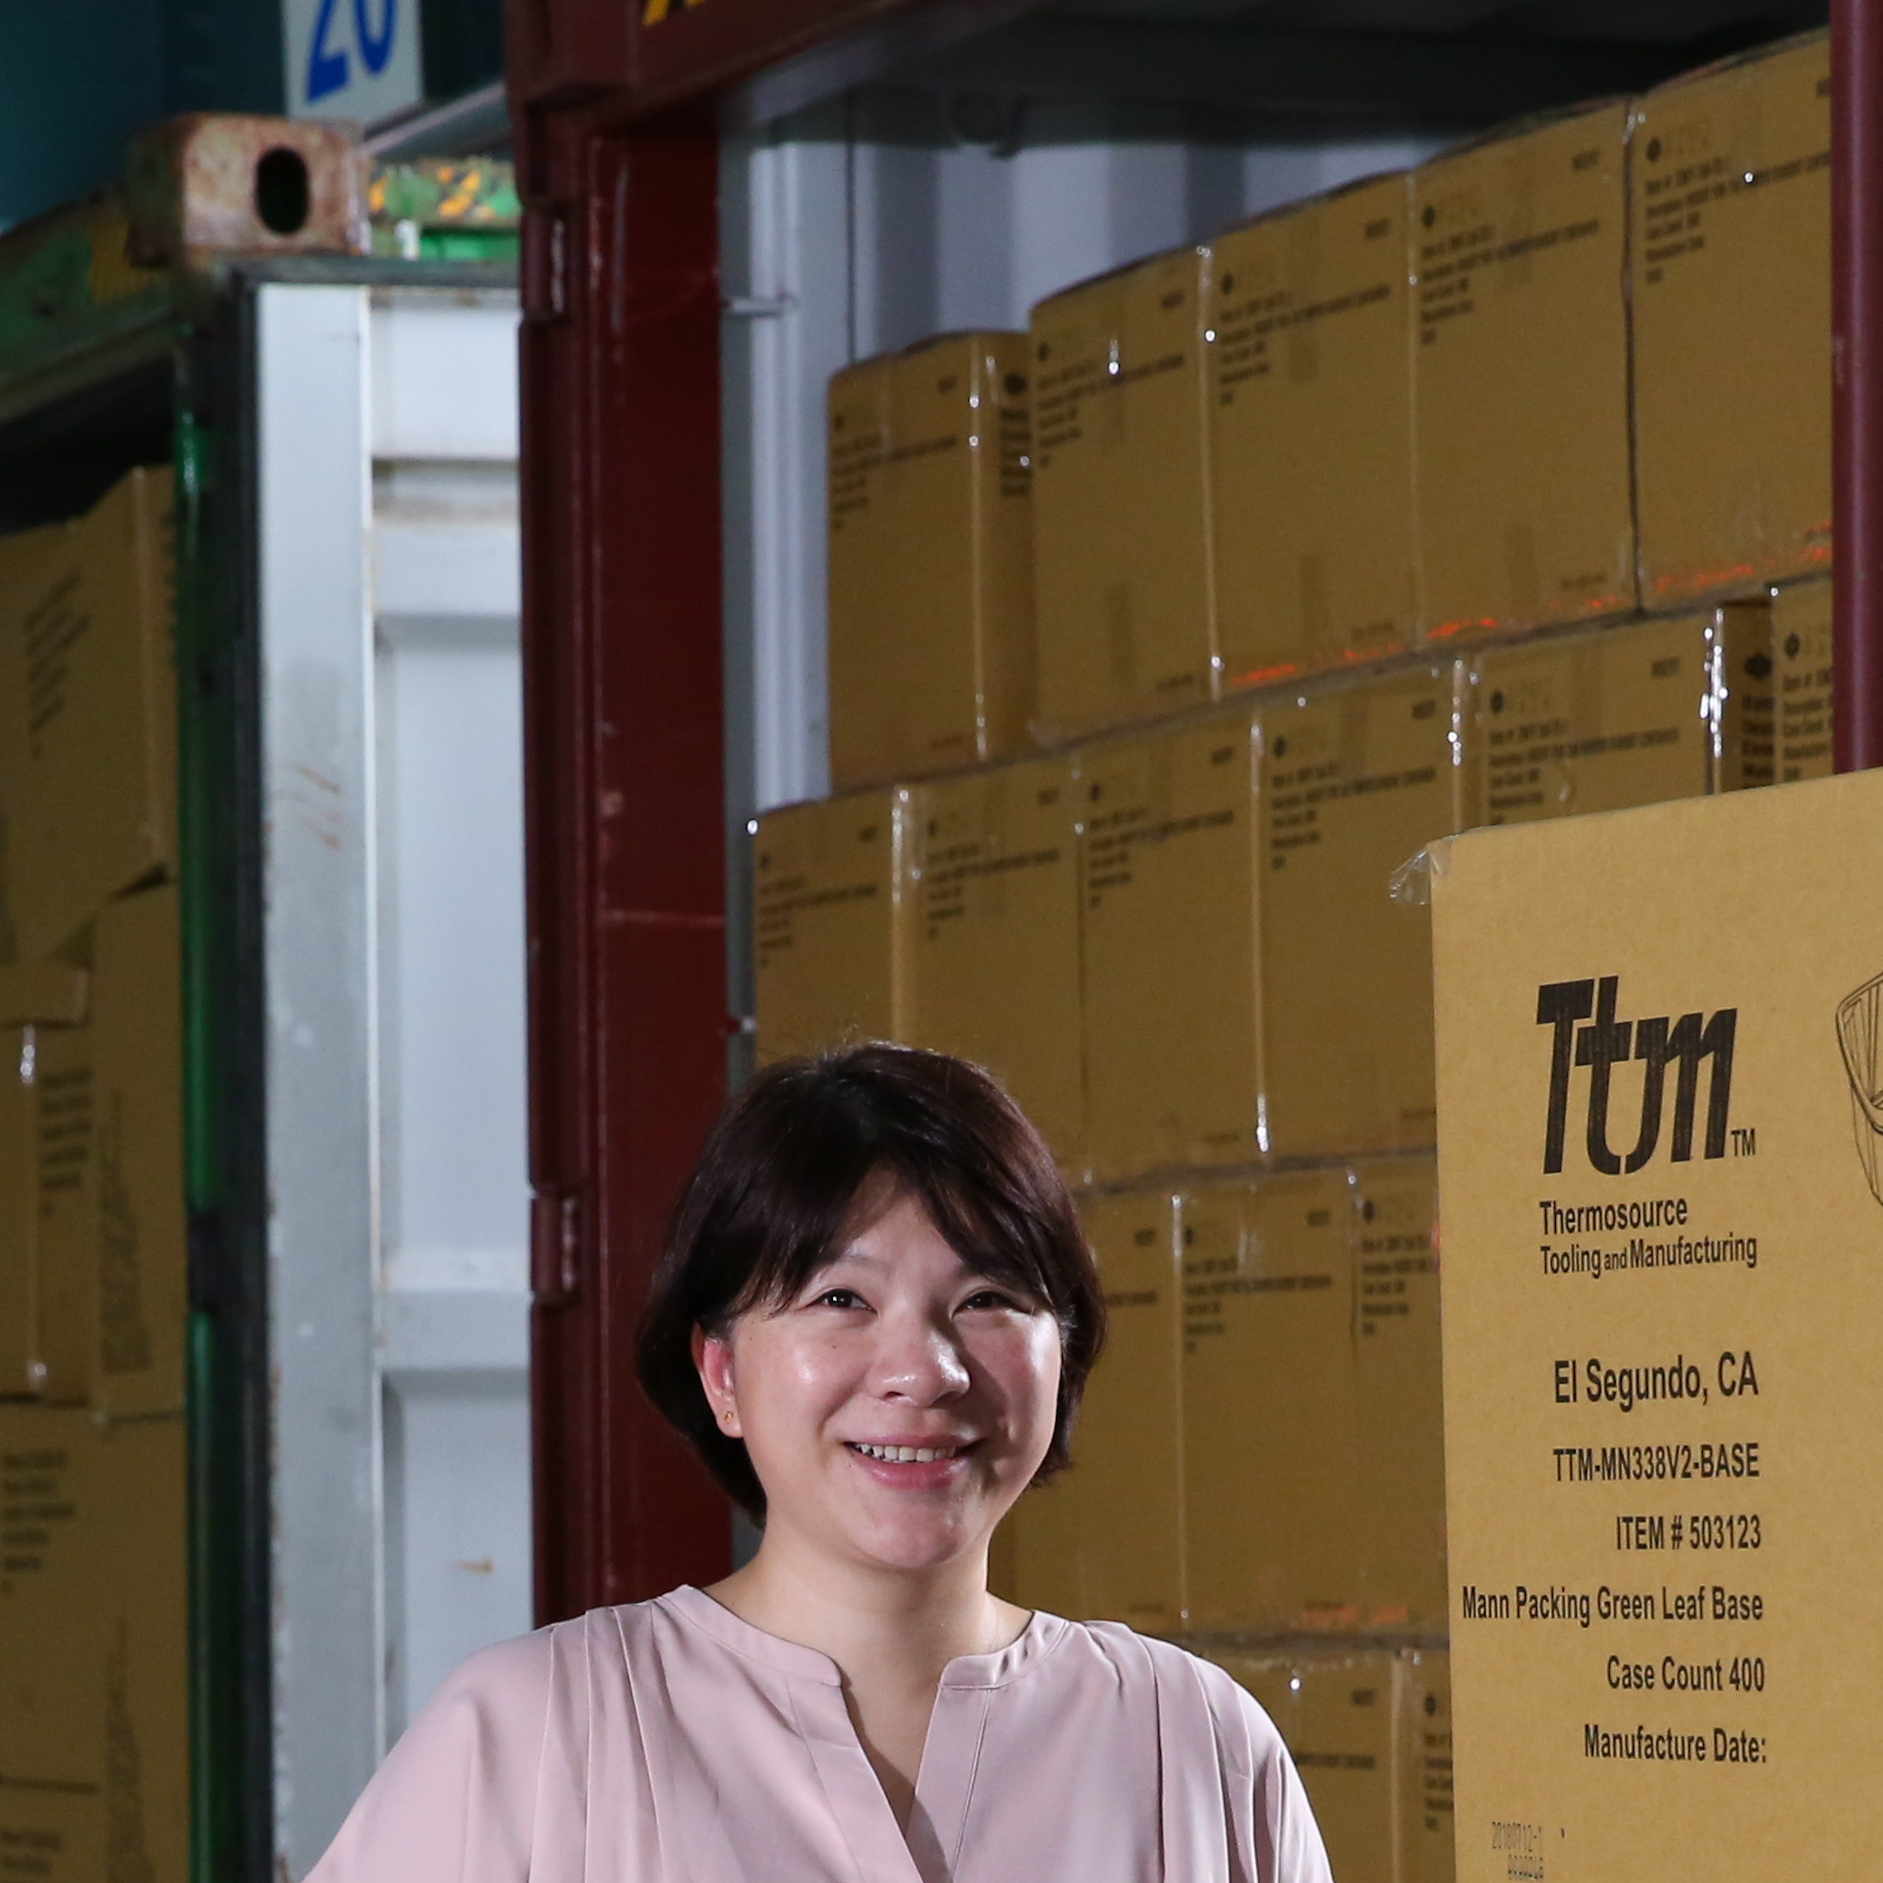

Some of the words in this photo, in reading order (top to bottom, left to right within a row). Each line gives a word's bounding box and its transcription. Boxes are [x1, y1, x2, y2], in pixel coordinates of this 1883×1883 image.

[1539, 1198, 1688, 1236] Thermosource
[1540, 1243, 1601, 1280] Tooling
[1604, 1247, 1628, 1271] and
[1630, 1235, 1757, 1269] Manufacturing
[1554, 1359, 1577, 1404] El
[1586, 1354, 1708, 1413] Segundo,
[1717, 1350, 1759, 1397] CA
[1552, 1442, 1760, 1482] TTM-MN338V2-BASE
[1616, 1515, 1665, 1551] ITEM
[1671, 1514, 1683, 1550] #
[1689, 1514, 1761, 1550] 503123
[1461, 1584, 1511, 1620] Mann
[1515, 1584, 1591, 1630] Packing
[1596, 1584, 1656, 1621] Green
[1661, 1584, 1705, 1621] Leaf
[1711, 1586, 1764, 1622] Base
[1607, 1654, 1655, 1690] Case
[1661, 1655, 1723, 1691] Count
[1729, 1656, 1765, 1692] 400
[1584, 1723, 1706, 1762] Manufacture
[1713, 1727, 1766, 1763] Date:
